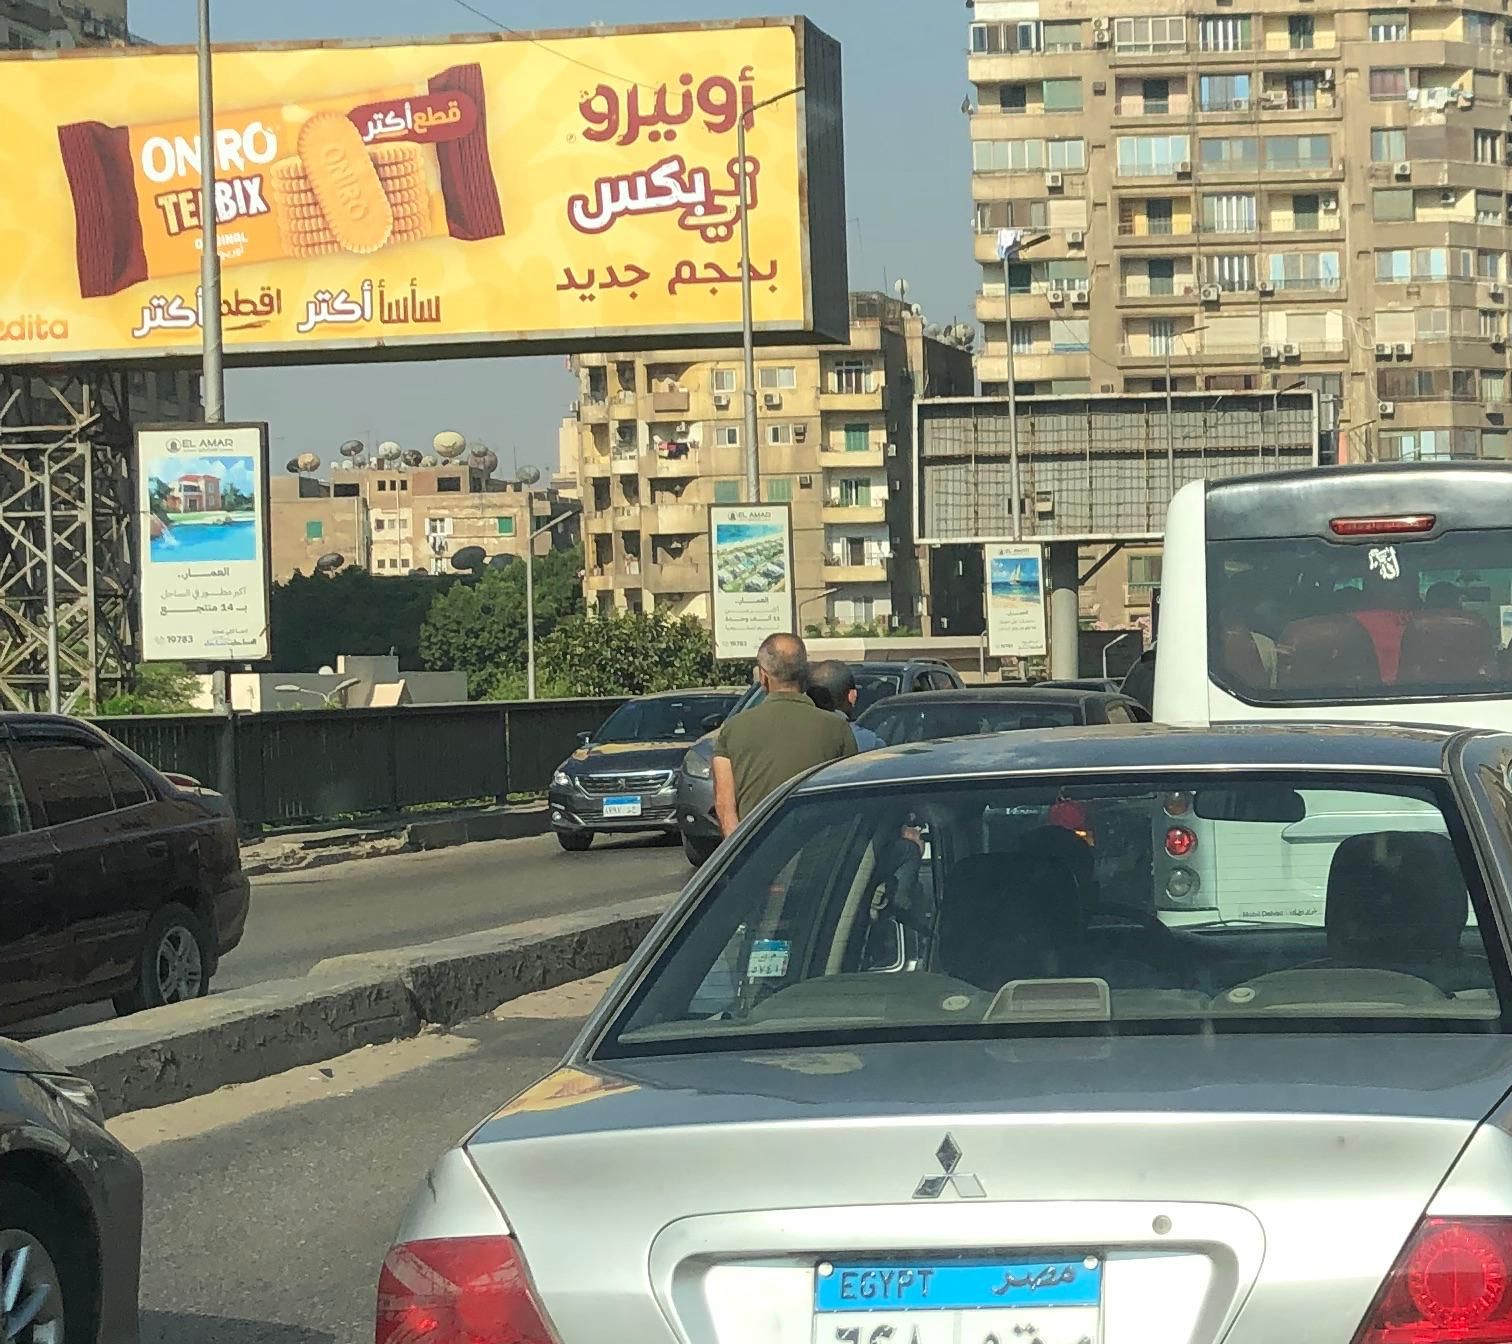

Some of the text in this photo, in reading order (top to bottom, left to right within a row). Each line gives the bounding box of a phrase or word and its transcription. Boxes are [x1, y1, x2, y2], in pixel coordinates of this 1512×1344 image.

[578, 64, 756, 146] أونيرو
[141, 120, 278, 183] ONRO
[556, 259, 651, 303] جديد
[182, 438, 234, 449] EL AMAR
[840, 1270, 935, 1301] EGYPT
[991, 1265, 1076, 1296] مصر
